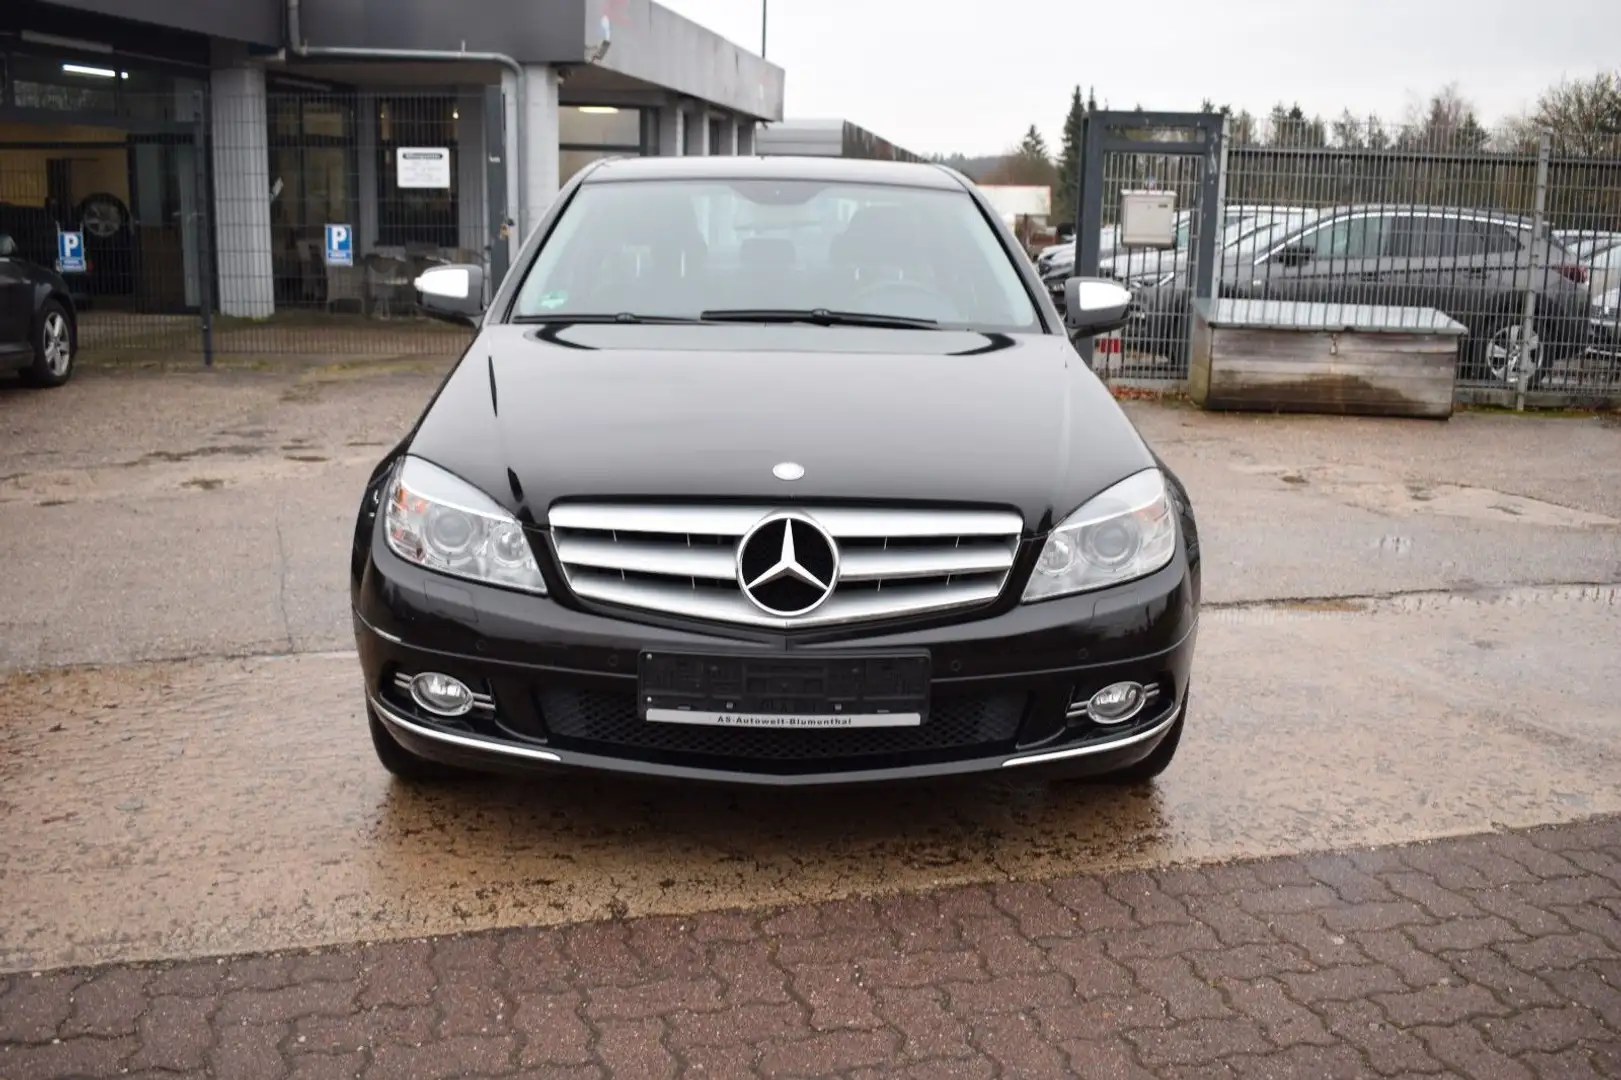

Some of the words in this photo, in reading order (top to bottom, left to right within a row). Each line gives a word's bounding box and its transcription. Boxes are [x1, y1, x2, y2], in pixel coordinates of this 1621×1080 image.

[64, 233, 79, 257] P
[331, 226, 347, 250] P
[717, 715, 852, 726] AS-Autowelt-Blumenthal
